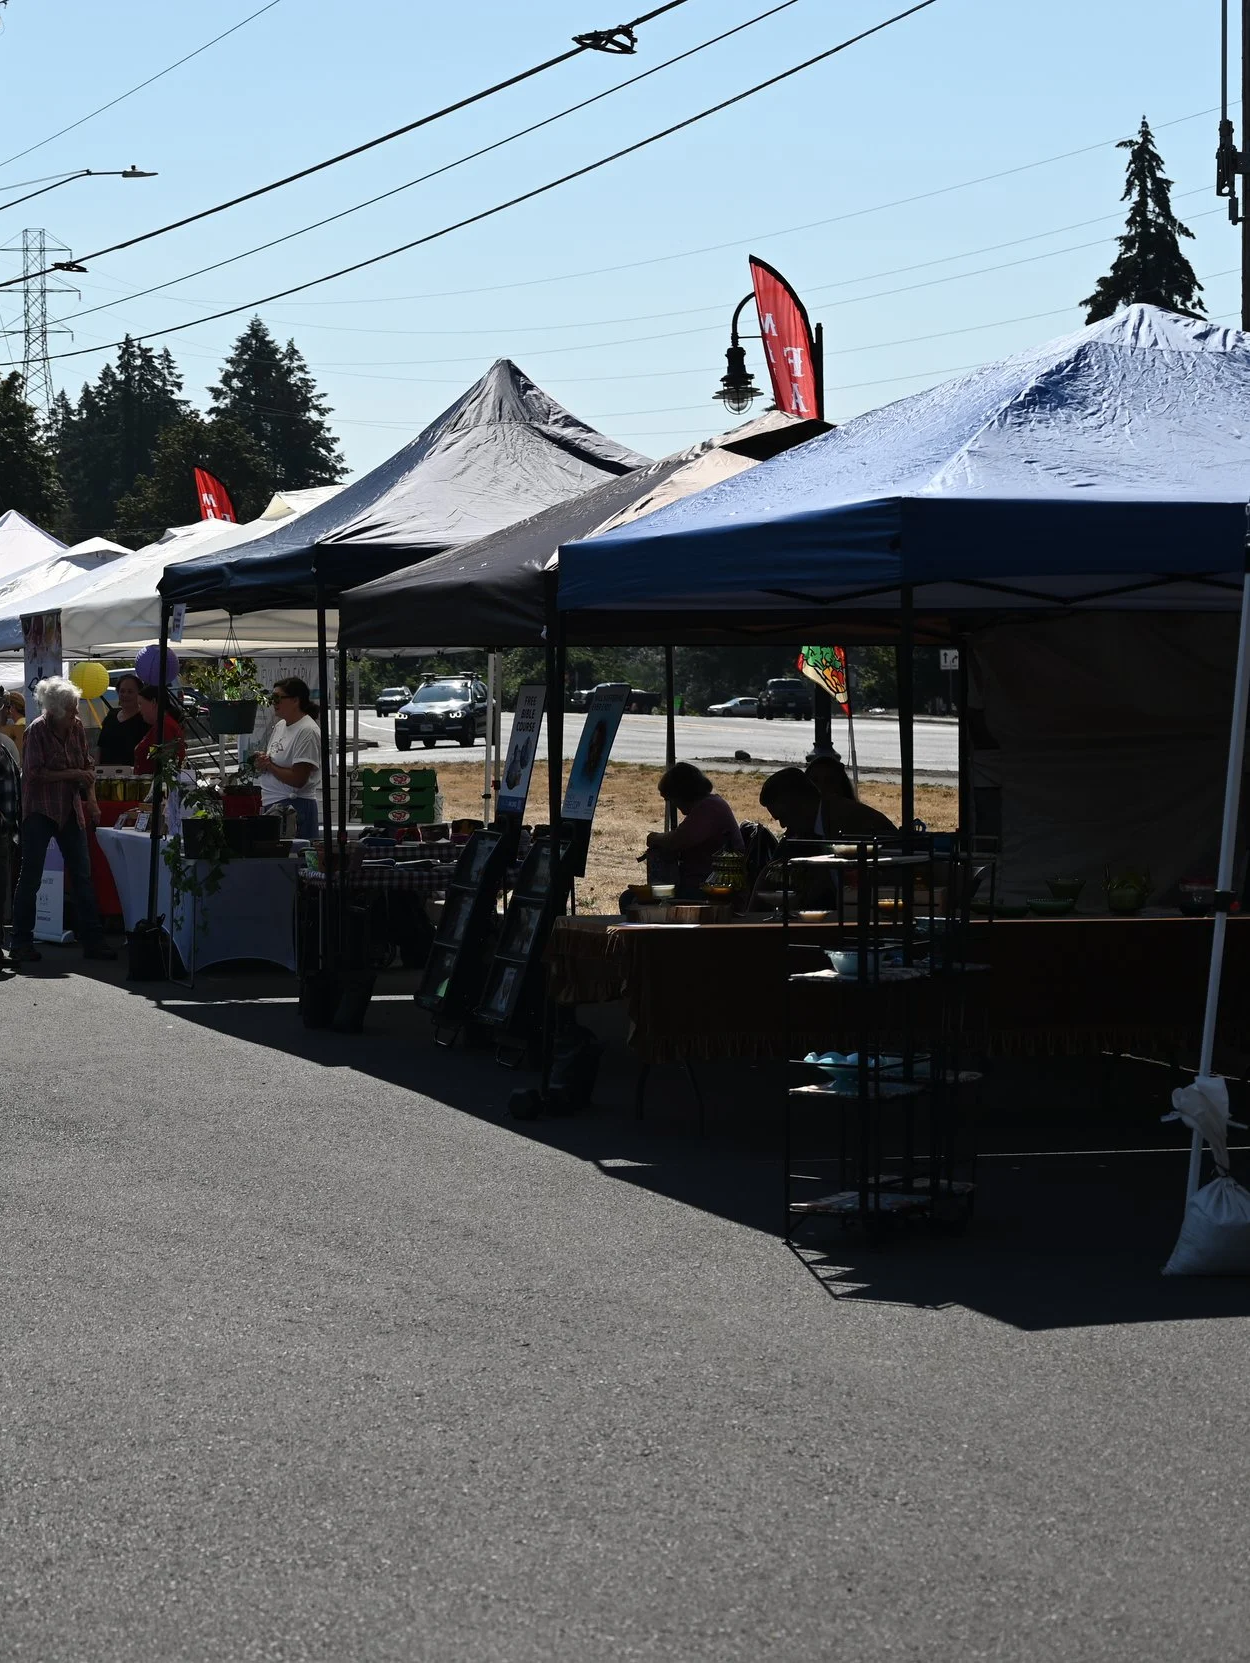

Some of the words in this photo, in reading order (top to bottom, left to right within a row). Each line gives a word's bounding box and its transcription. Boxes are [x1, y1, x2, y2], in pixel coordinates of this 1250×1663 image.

[525, 696, 537, 707] FREE
[521, 708, 536, 719] BIBLE
[516, 722, 536, 733] COURSE
